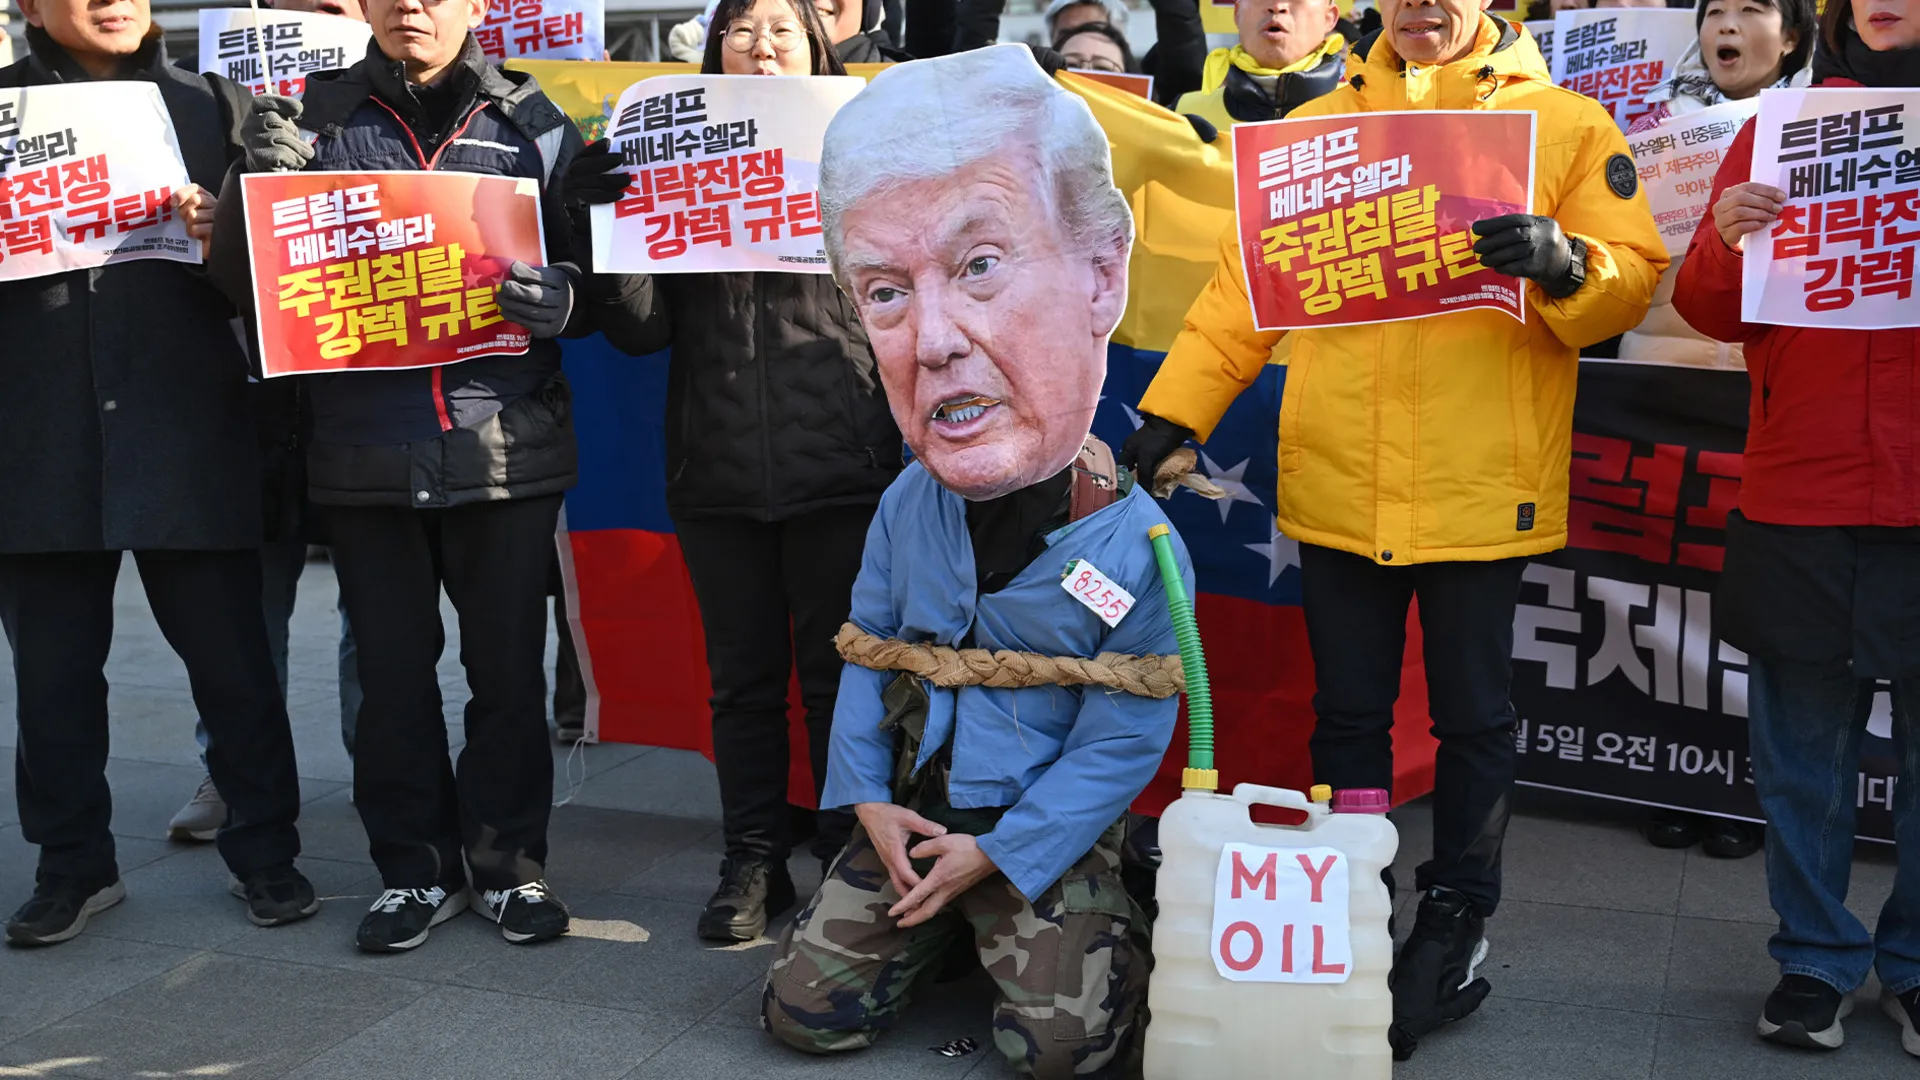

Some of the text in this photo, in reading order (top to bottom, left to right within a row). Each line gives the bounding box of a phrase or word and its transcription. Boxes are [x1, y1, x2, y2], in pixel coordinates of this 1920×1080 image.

[218, 22, 303, 59] 트럼프
[514, 12, 583, 54] 규탄!
[1564, 18, 1617, 54] 트럼프
[1566, 39, 1648, 74] 베네수엘라
[228, 47, 346, 82] 베네수엘라
[613, 88, 708, 138] 트럼프
[1681, 120, 1736, 146] 민중들과
[1777, 104, 1904, 163] 트럼프
[621, 119, 758, 167] 베네수엘라
[1258, 126, 1359, 190] 트럼프
[1664, 148, 1721, 176] 제국주의
[272, 184, 381, 237] 트럼프
[615, 148, 785, 219] 침략전쟁
[1270, 154, 1412, 220] 베네수엘라
[66, 186, 172, 244] 규탄!
[288, 213, 436, 267] 베네수엘라
[645, 204, 732, 260] 강력
[1260, 184, 1441, 272] 주권침탈
[277, 242, 465, 318] 주권침탈
[1296, 252, 1388, 316] 강력
[1804, 245, 1915, 313] 강력
[315, 301, 408, 360] 강력
[1074, 571, 1128, 618] 8255
[1536, 724, 1584, 762] 5일
[1593, 732, 1656, 772] 오전
[1666, 743, 1734, 785] 10시
[1231, 850, 1337, 902] MY
[1220, 921, 1345, 975] OIL
